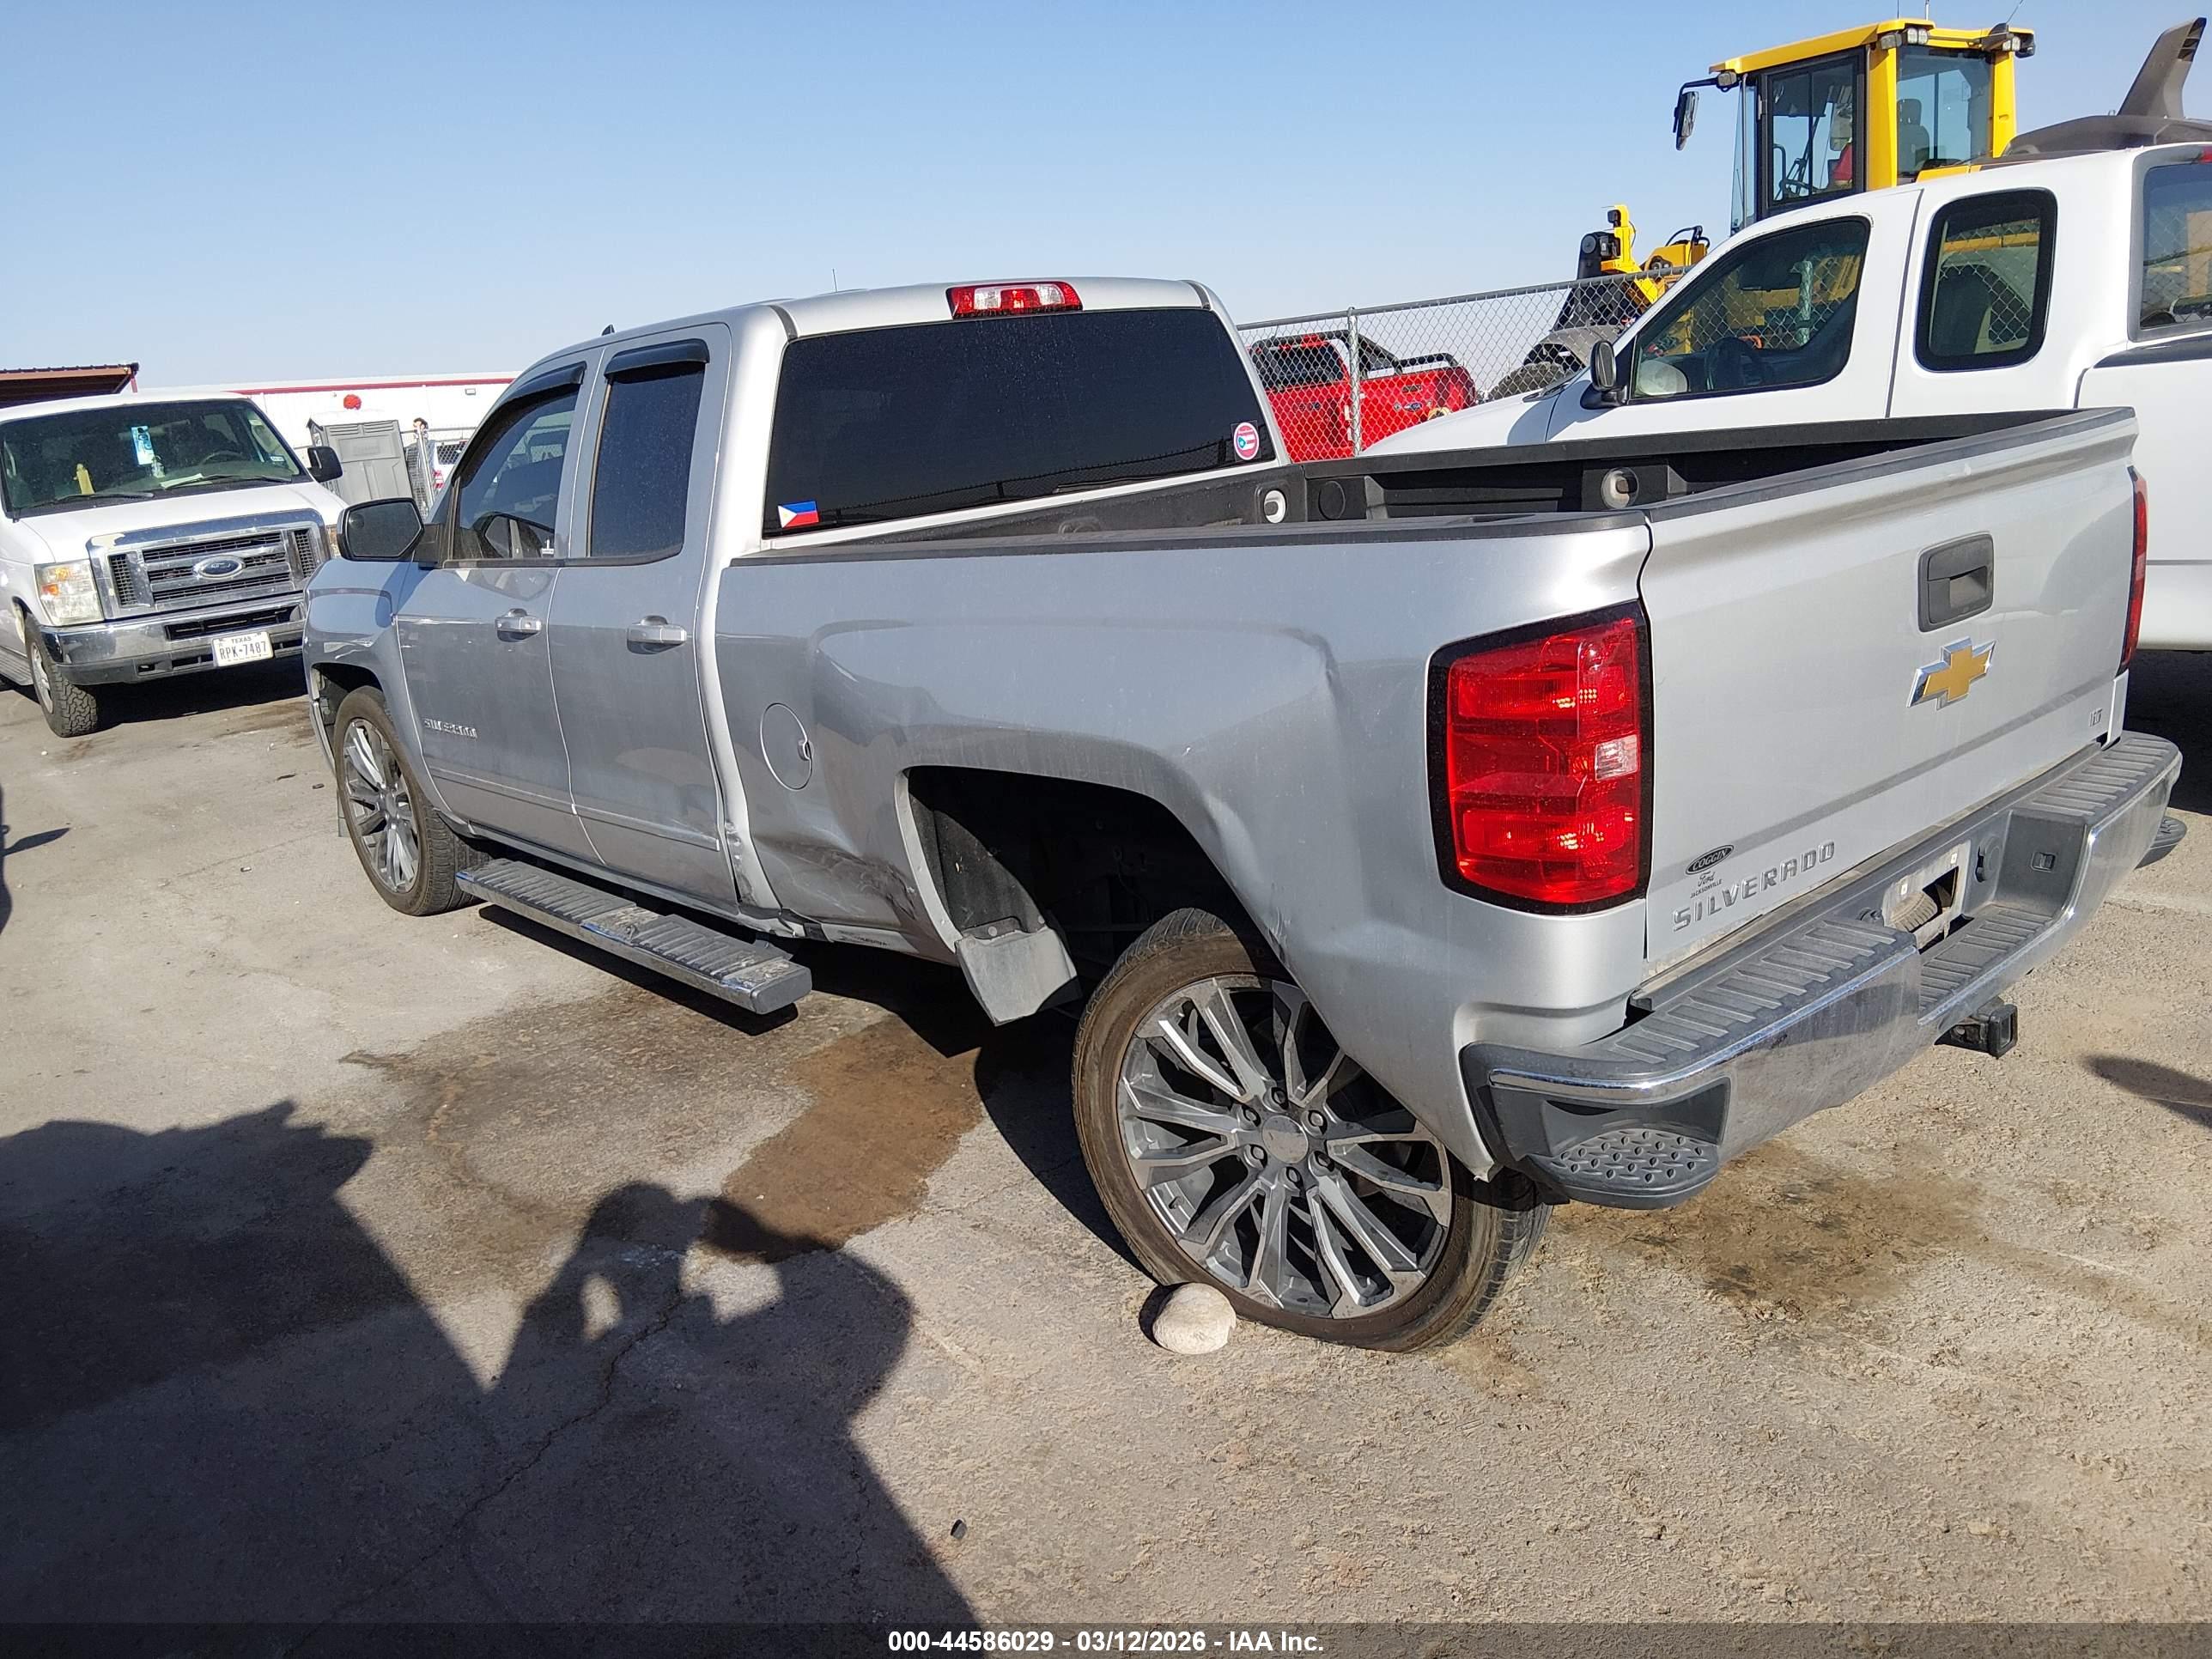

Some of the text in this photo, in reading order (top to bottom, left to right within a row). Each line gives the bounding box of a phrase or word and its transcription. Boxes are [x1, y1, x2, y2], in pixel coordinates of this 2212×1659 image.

[1692, 848, 1729, 871] COGGIN
[1673, 841, 1835, 932] SILVERADO
[1690, 878, 1722, 898] JACKSONVILLE
[1698, 871, 1716, 887] Ford
